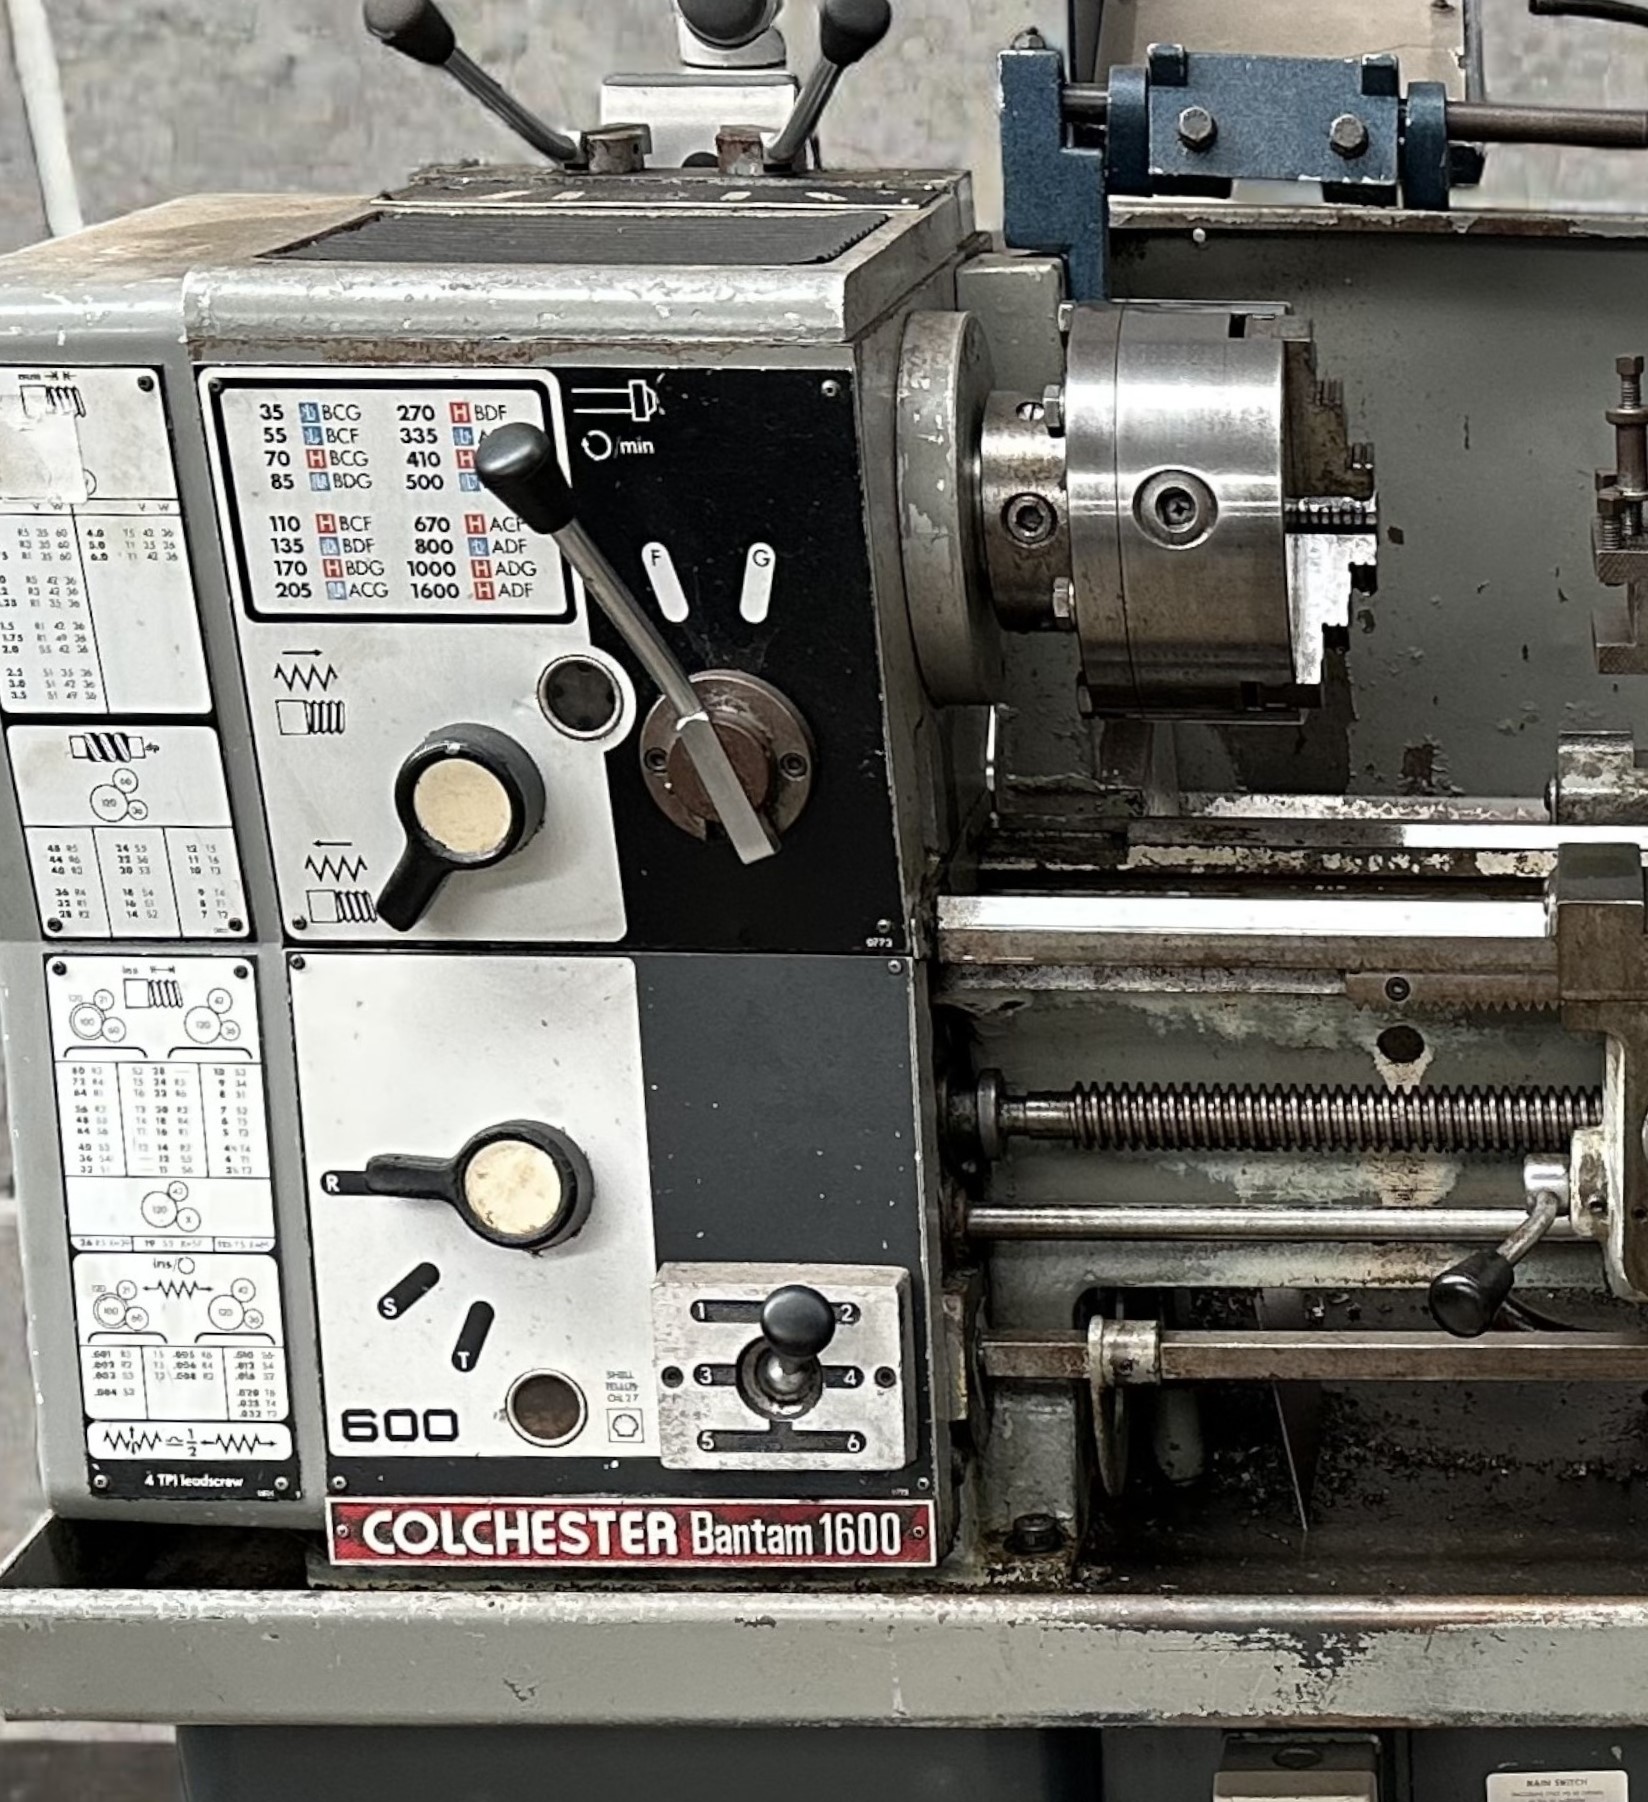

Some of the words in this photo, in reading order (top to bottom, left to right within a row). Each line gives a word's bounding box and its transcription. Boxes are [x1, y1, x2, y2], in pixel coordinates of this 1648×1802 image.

[259, 404, 284, 421] 35
[322, 404, 361, 421] BCG
[397, 405, 435, 421] 270
[452, 404, 469, 421] H
[475, 405, 507, 421] BDF
[264, 427, 287, 443] 55
[326, 429, 359, 443] BCF
[400, 428, 438, 443] 335
[265, 451, 290, 466] 70
[308, 451, 325, 467] H
[330, 451, 368, 466] BCG
[407, 452, 441, 467] 410
[458, 451, 475, 466] H
[271, 474, 294, 489] 85
[334, 473, 372, 489] BDG
[406, 474, 444, 490] 500
[269, 516, 300, 532] 110
[318, 516, 335, 532] H
[339, 516, 372, 531] BCF
[415, 517, 450, 532] 670
[466, 516, 484, 532] H
[271, 538, 304, 553] 135
[343, 538, 375, 553] BDF
[415, 539, 453, 554] 800
[492, 539, 527, 554] ADF
[651, 549, 662, 566] F
[752, 549, 770, 567] G
[274, 561, 307, 576] 170
[325, 561, 342, 576] H
[346, 560, 384, 576] BDG
[407, 561, 456, 576] 1000
[473, 562, 490, 576] H
[496, 561, 536, 576] ADG
[275, 583, 311, 598] 205
[349, 583, 388, 598] ACG
[410, 583, 459, 598] 1600
[476, 584, 493, 598] H
[499, 583, 533, 598] ADF
[325, 1174, 340, 1192] R
[383, 1298, 398, 1316] S
[698, 1303, 706, 1320] 1
[840, 1305, 853, 1321] 2
[457, 1352, 470, 1369] T
[699, 1367, 712, 1384] 3
[843, 1370, 857, 1386] 4
[341, 1408, 459, 1442] 600
[701, 1432, 715, 1450] 5
[846, 1436, 860, 1453] 6
[180, 1474, 244, 1487] leadscrew
[362, 1509, 679, 1556] COLCHESTER
[690, 1510, 814, 1556] Bantam
[818, 1512, 901, 1556] 1600
